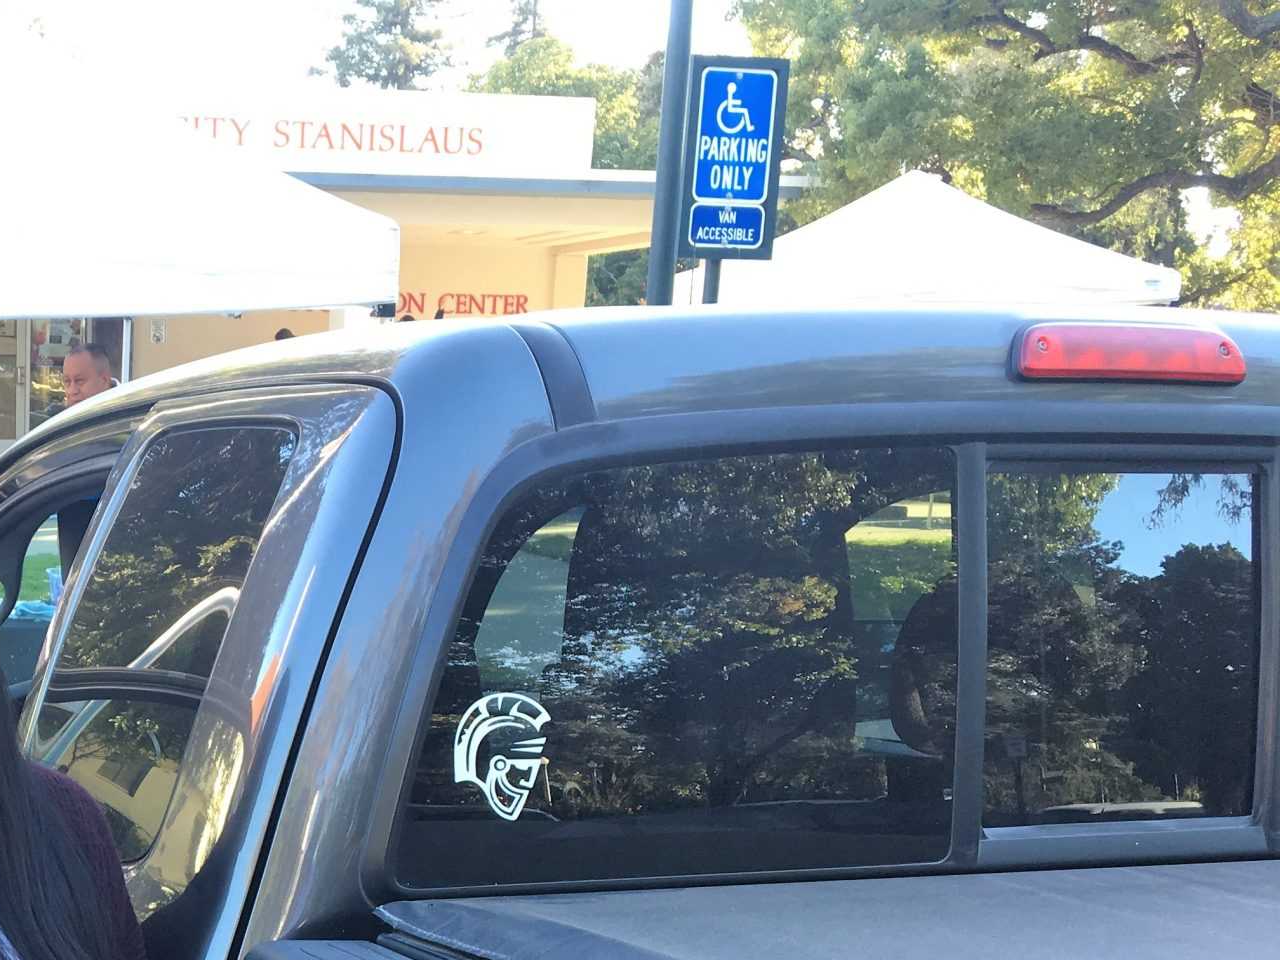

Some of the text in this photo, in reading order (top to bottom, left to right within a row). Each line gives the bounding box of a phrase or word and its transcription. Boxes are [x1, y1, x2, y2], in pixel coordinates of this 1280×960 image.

[273, 119, 484, 155] STANISLAUS
[700, 136, 768, 163] PARKING
[710, 165, 753, 190] ONLY
[719, 210, 737, 224] VAN
[696, 227, 755, 242] ACCESSIBLE
[438, 292, 529, 315] CENTER
